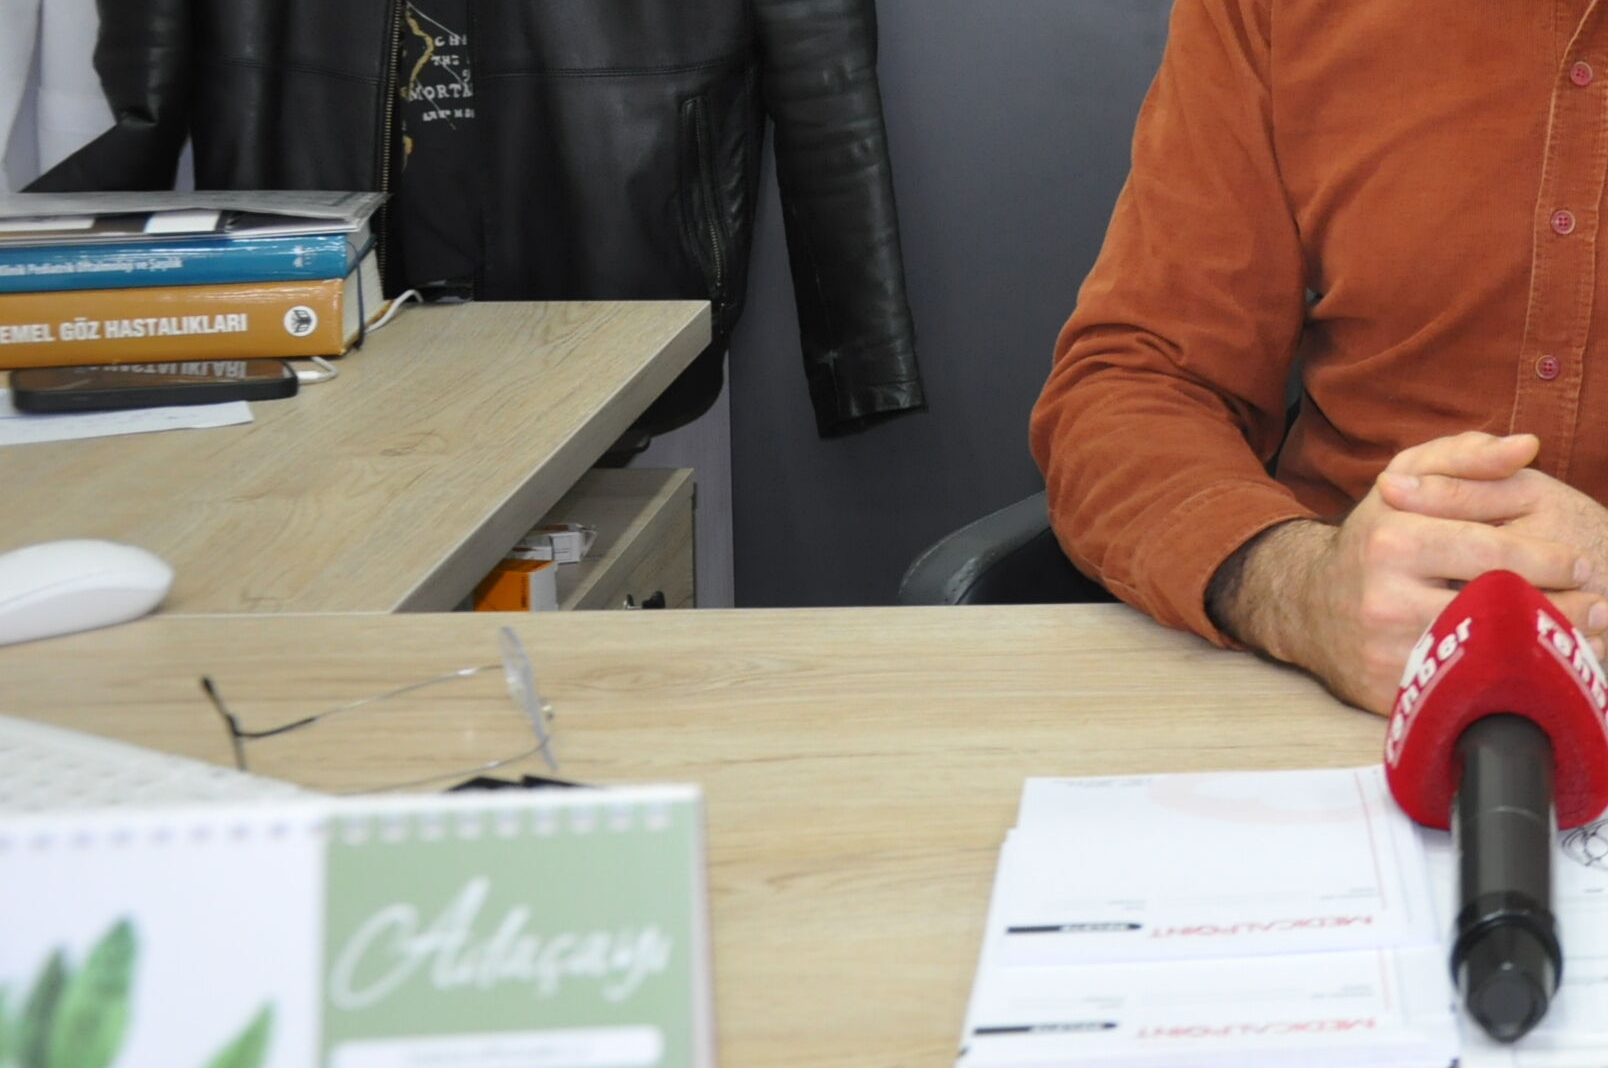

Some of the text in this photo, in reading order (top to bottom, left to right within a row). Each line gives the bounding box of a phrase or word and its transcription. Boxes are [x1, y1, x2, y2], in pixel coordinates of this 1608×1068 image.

[58, 316, 101, 342] GÖZ
[103, 312, 248, 340] HASTALIKLARI
[1150, 915, 1374, 940] MEDICALPOINT
